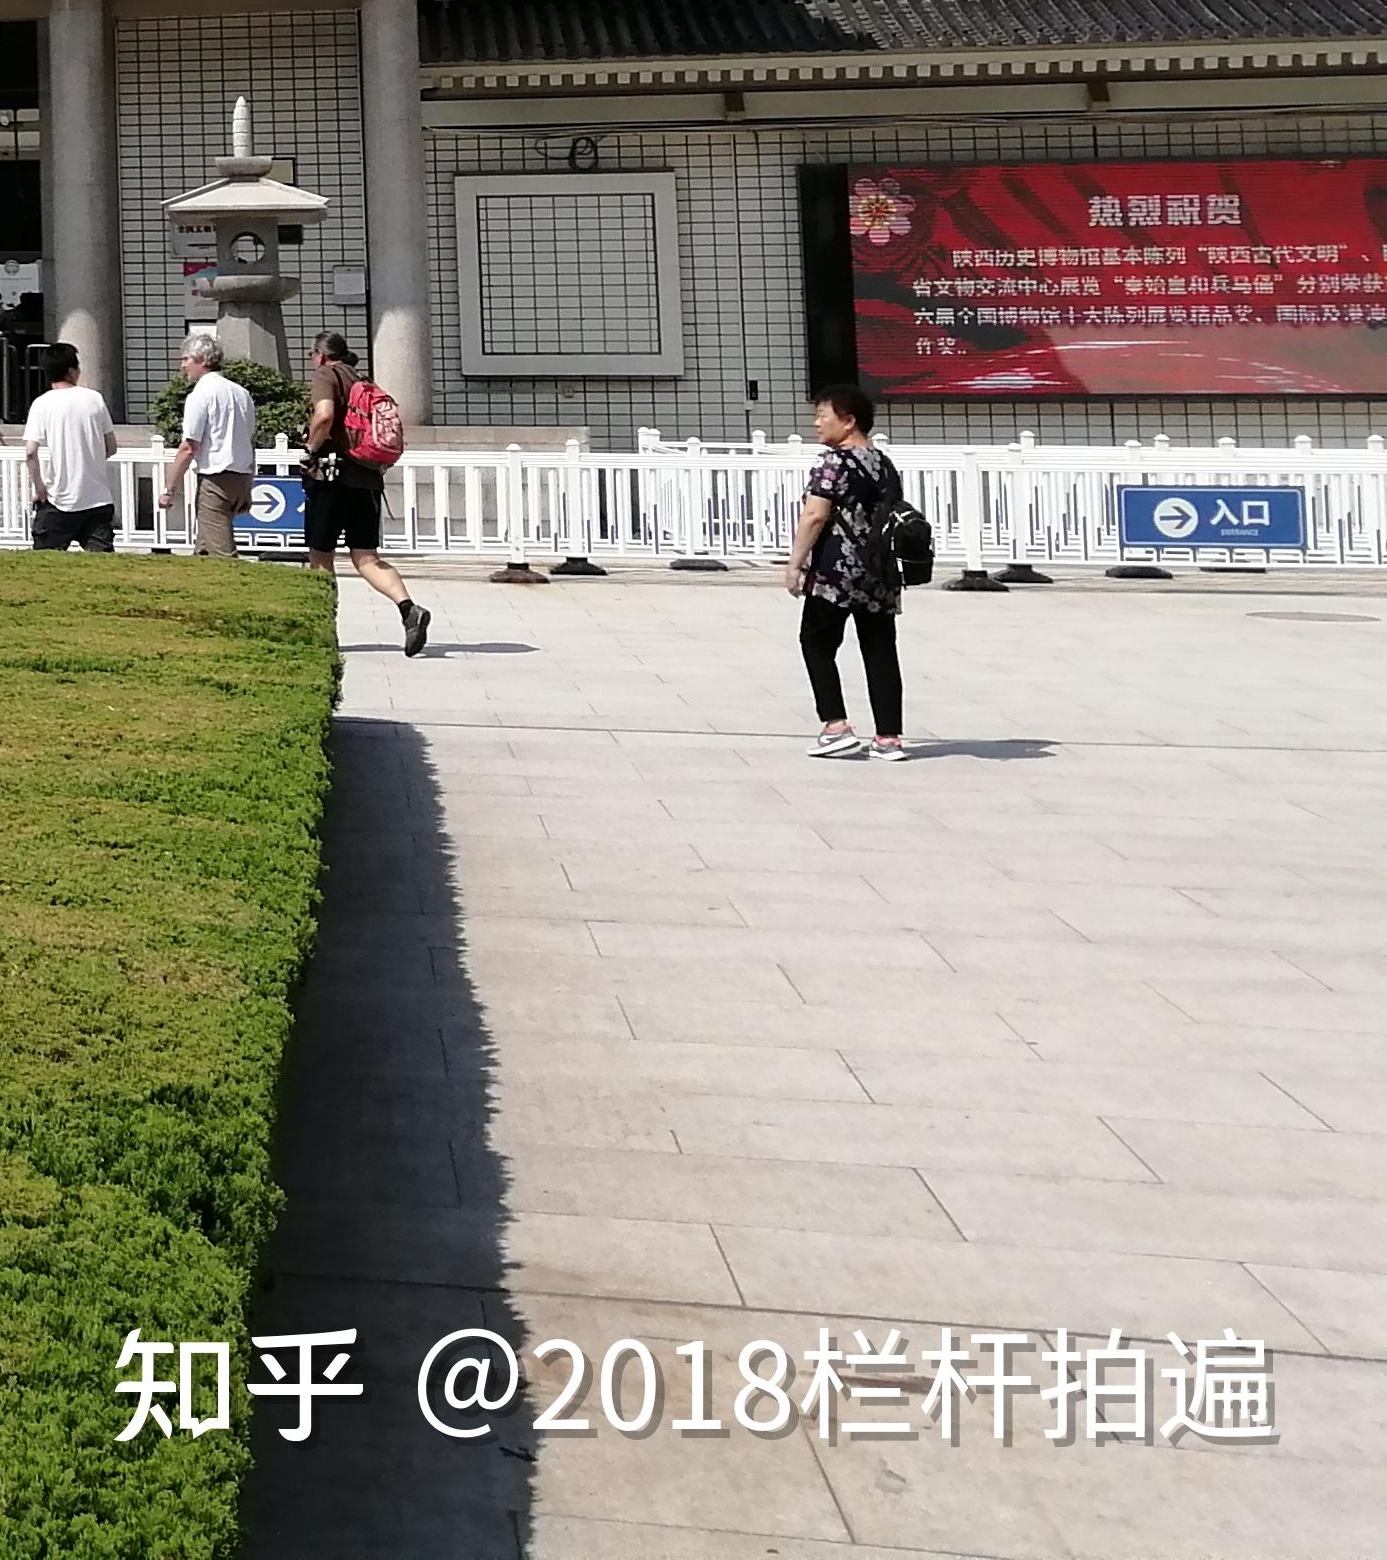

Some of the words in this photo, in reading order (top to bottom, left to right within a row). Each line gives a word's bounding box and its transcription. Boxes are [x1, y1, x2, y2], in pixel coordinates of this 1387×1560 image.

[1088, 195, 1242, 227] 热烈祝贺
[952, 244, 1387, 267] 陕西历史博物馆基本陈列“陕西古代文明”、
[1210, 499, 1270, 526] 入口
